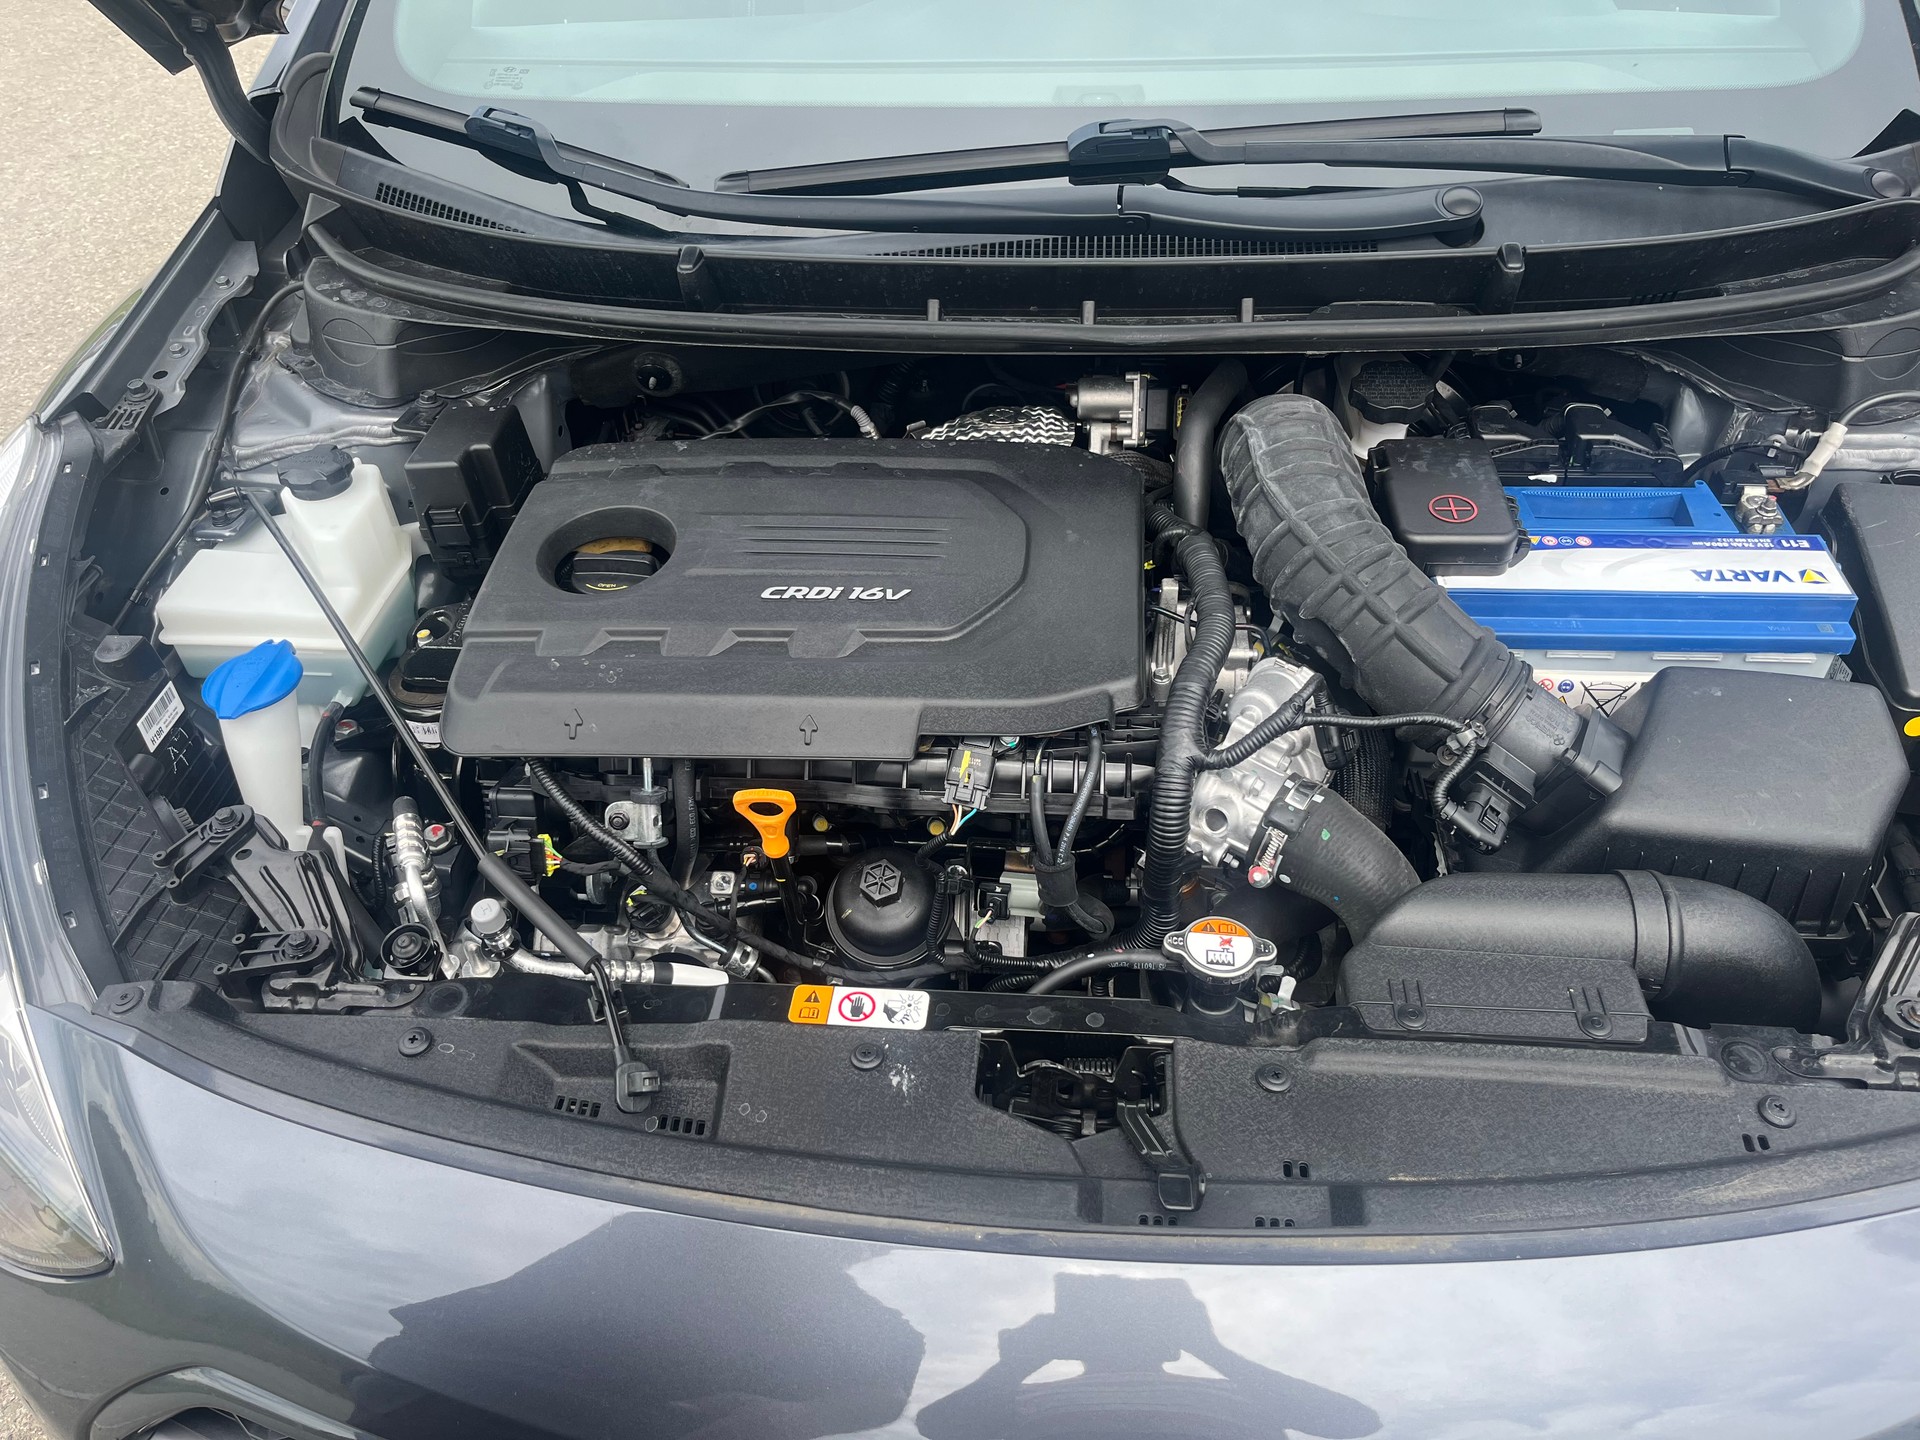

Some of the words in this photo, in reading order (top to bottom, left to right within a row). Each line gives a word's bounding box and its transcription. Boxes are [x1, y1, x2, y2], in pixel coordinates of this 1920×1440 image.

[1780, 539, 1810, 548] E11
[1690, 569, 1795, 583] VARTA
[760, 586, 845, 600] CRDi
[848, 587, 912, 600] 16V
[1167, 937, 1184, 946] HCC
[1260, 944, 1273, 952] 1.1
